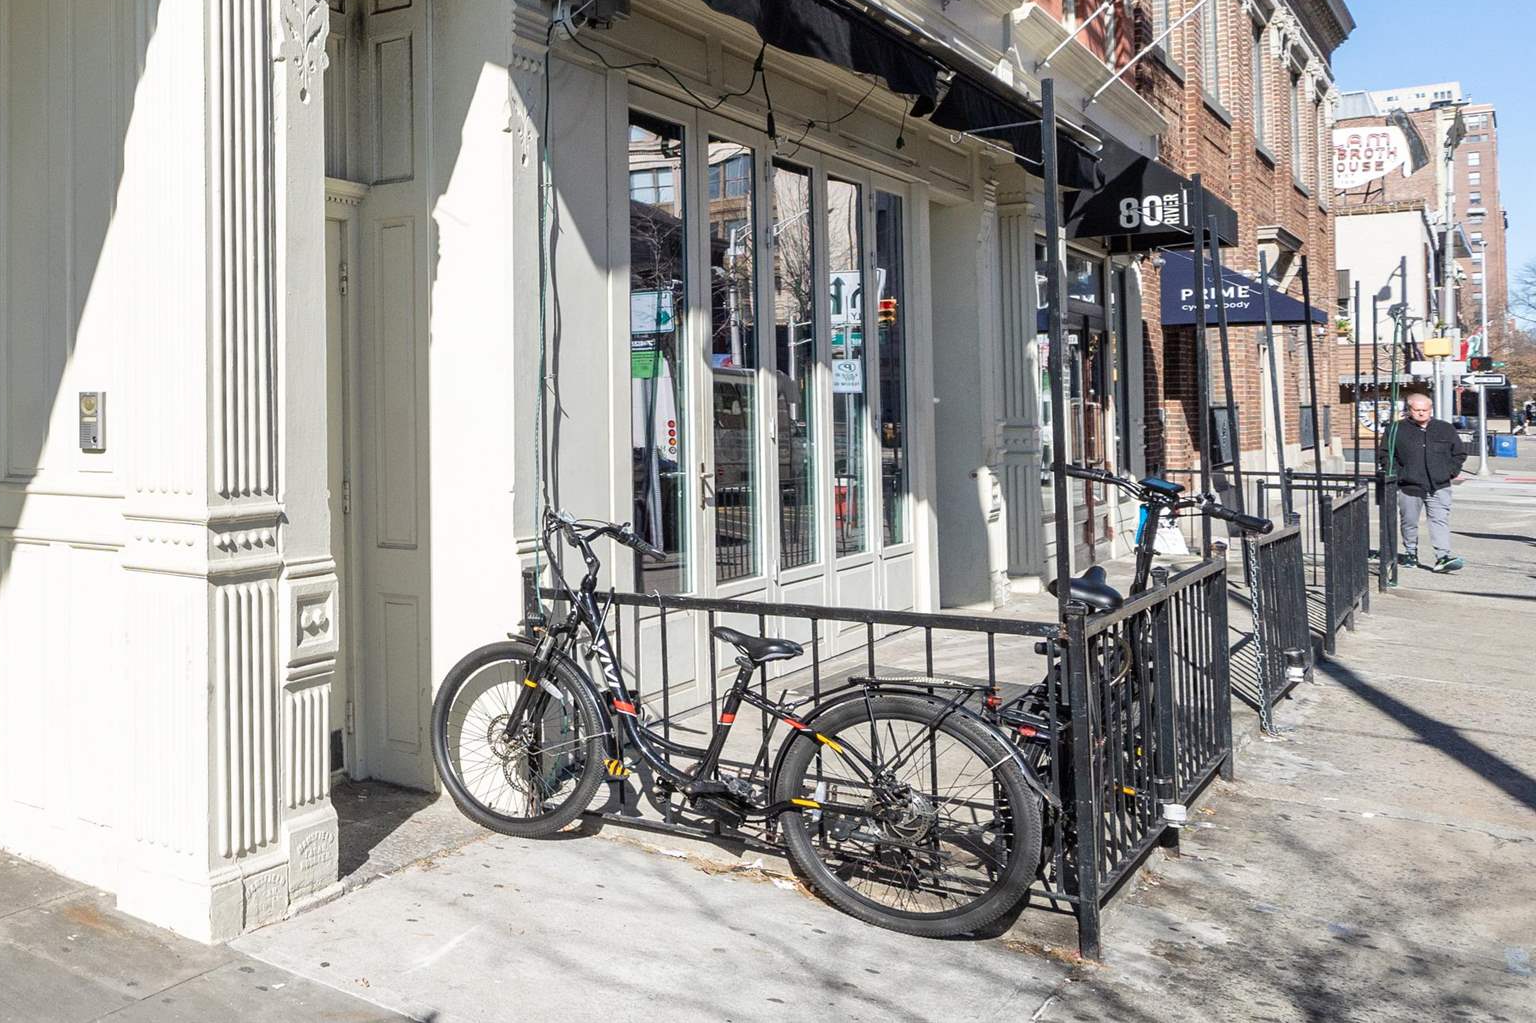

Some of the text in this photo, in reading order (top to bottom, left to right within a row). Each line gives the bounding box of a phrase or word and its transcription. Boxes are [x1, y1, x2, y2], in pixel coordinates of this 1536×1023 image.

[1338, 147, 1397, 160] BROTH
[1336, 160, 1384, 173] OUSE
[1119, 195, 1163, 228] 80
[1162, 193, 1180, 225] RIVER
[1181, 303, 1211, 311] cye
